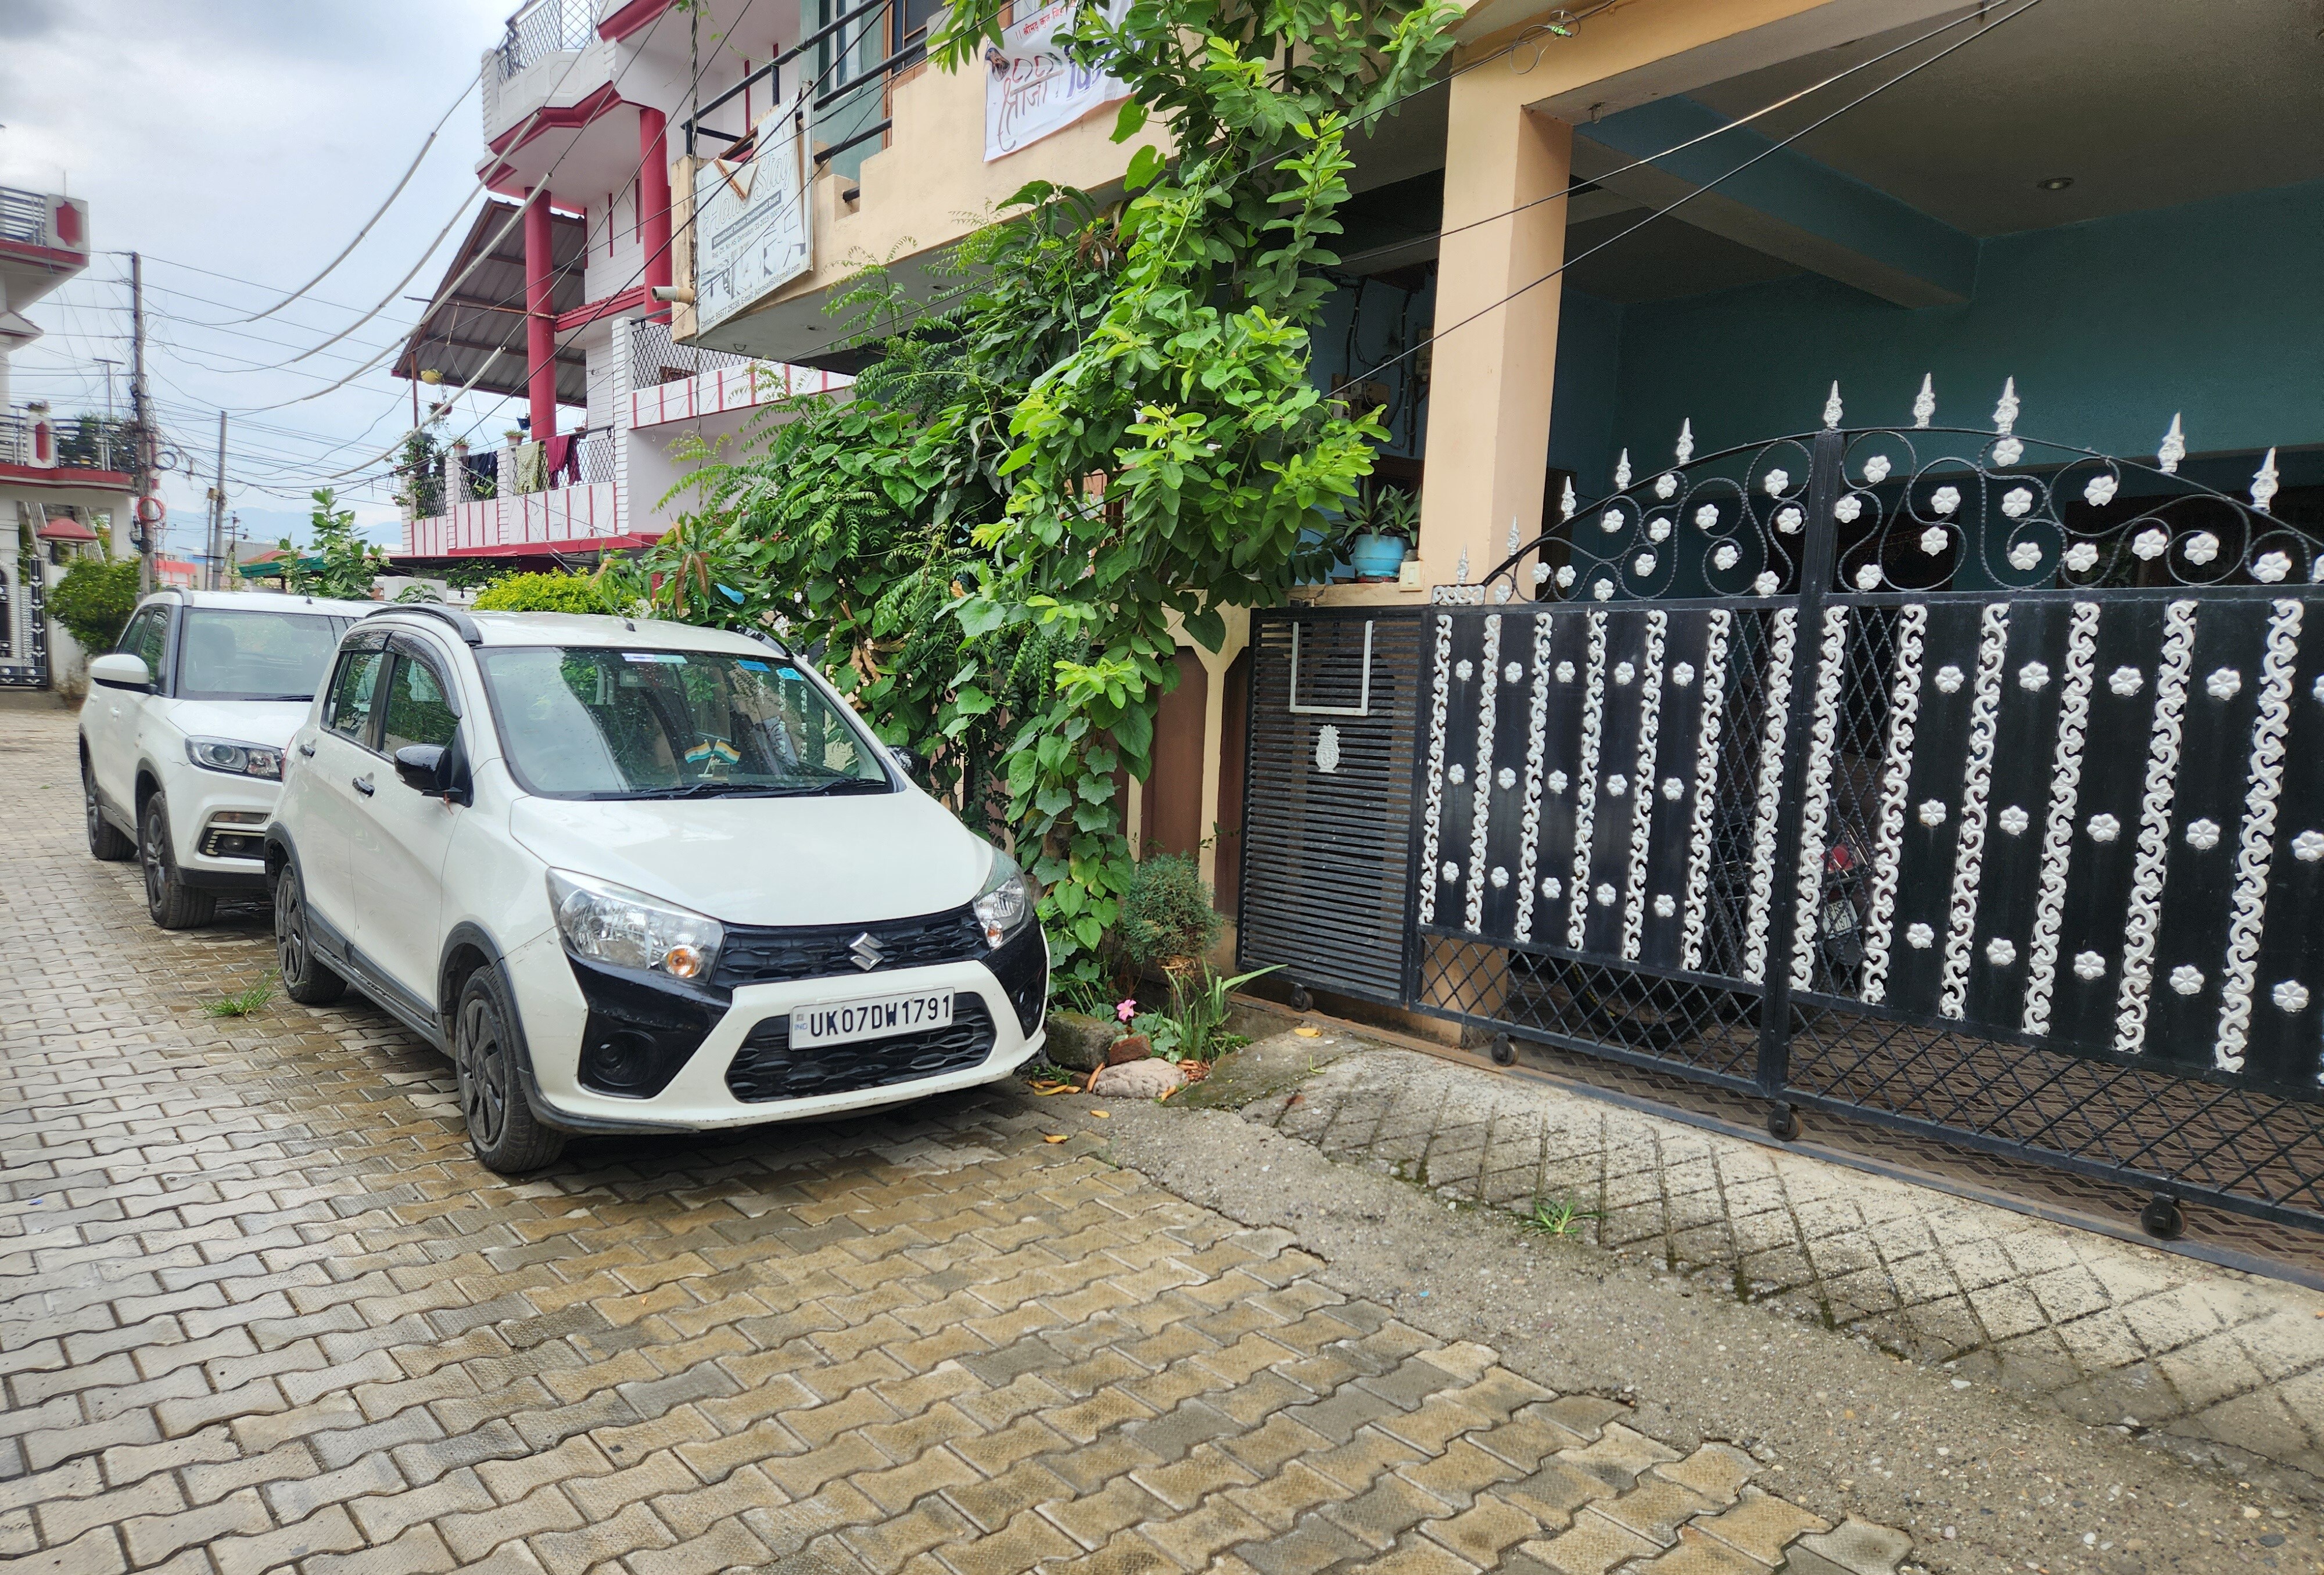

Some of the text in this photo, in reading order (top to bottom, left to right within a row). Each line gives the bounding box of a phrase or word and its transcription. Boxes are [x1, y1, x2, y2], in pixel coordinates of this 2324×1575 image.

[754, 149, 792, 201] Stay
[713, 193, 779, 246] Uttarakhand Tourism Development Board
[811, 995, 950, 1037] UK07DW1791
